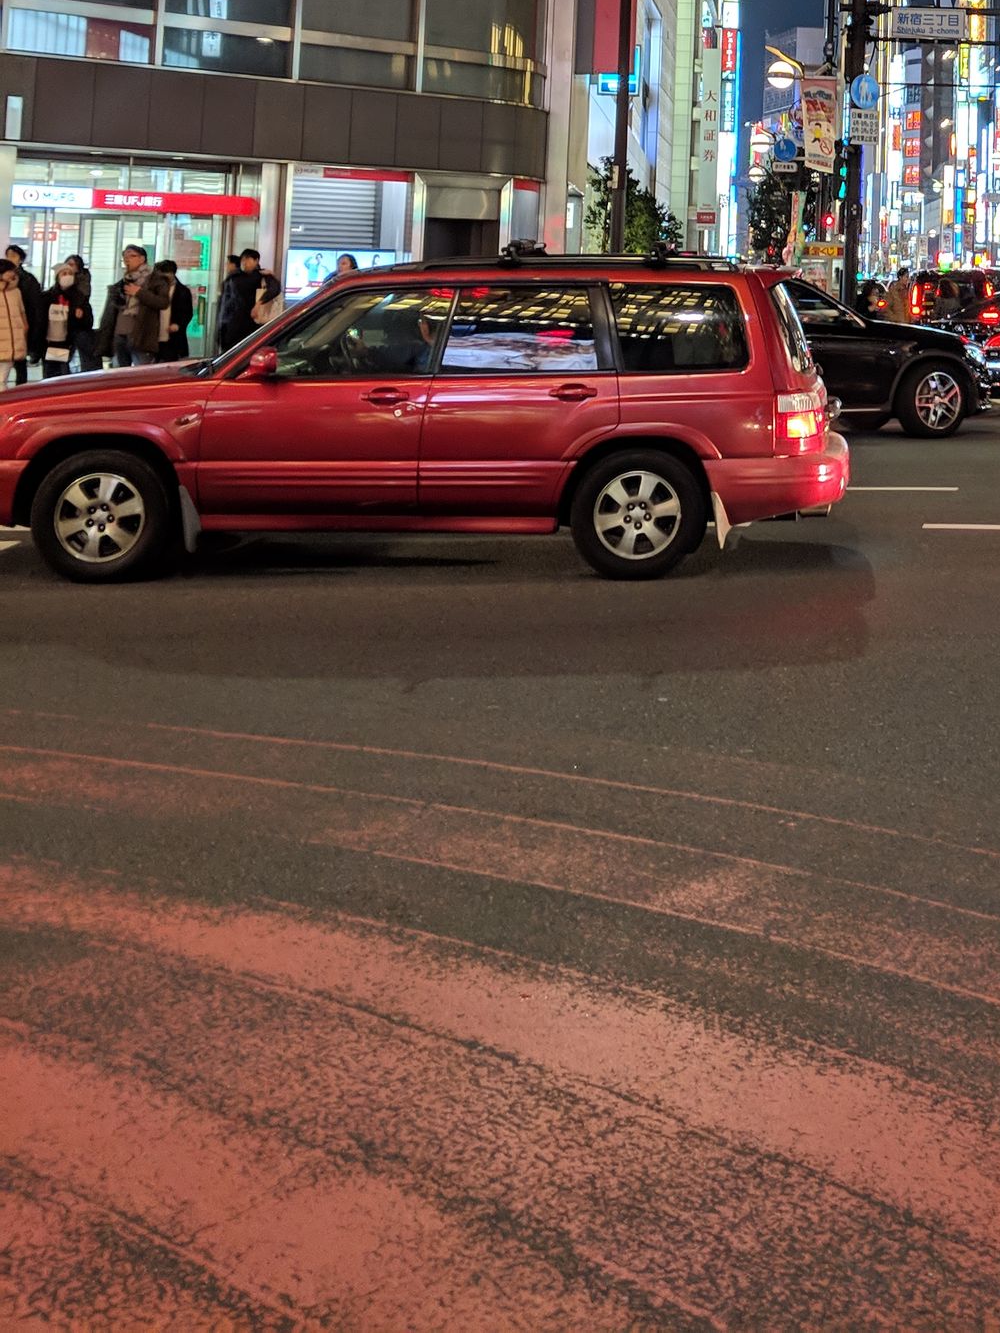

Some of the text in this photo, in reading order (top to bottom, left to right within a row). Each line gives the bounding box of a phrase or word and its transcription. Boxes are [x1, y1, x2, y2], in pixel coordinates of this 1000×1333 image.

[897, 13, 959, 27] 新宿三丁目
[896, 27, 926, 35] Shinjuku
[703, 89, 717, 163] 大和証券
[42, 192, 76, 202] MUFG
[104, 194, 163, 207] 三菱UFJ銀行
